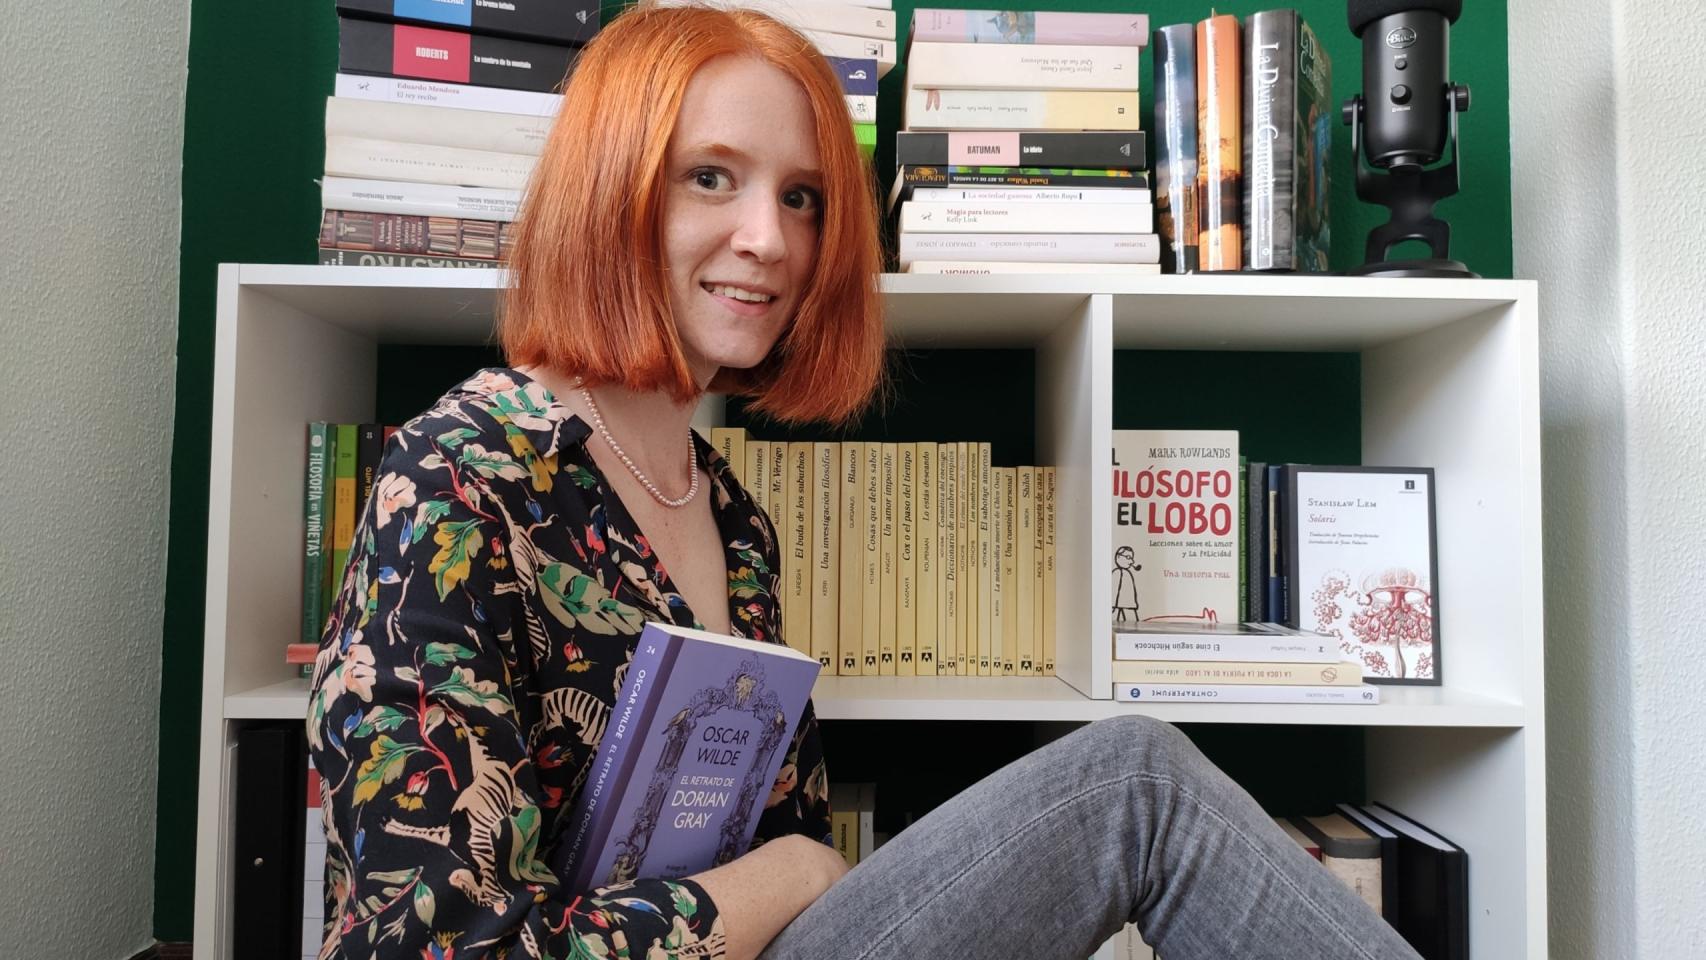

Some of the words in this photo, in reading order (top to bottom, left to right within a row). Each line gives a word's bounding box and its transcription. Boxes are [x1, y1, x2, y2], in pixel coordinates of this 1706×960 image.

[415, 46, 449, 60] ROBERTS
[1259, 42, 1279, 64] La
[397, 82, 428, 91] Eduardo
[428, 84, 460, 94] Mendoza
[1258, 67, 1279, 121] Divina
[967, 145, 1001, 154] BATUMAN
[904, 174, 946, 183] ALFAGUARA
[1006, 176, 1027, 184] Wallace
[1027, 176, 1049, 185] Daniel
[946, 209, 966, 217] Magia
[946, 216, 961, 224] Kelly
[773, 447, 783, 478] Vértigo
[821, 448, 831, 489] filosófica
[847, 449, 857, 484] Blancos
[869, 448, 877, 474] saber
[903, 450, 912, 482] tiempo
[922, 451, 930, 488] deseando
[939, 451, 947, 480] enemigo
[947, 450, 956, 481] propios
[308, 452, 324, 501] FILOSOFÍA
[797, 451, 805, 494] suburbios
[884, 452, 893, 496] imposible
[1113, 464, 1232, 498] ILÓSOFO
[773, 480, 781, 493] Mr.
[868, 481, 877, 503] debes
[902, 484, 911, 499] del
[1005, 475, 1014, 507] personal
[796, 498, 804, 510] los
[922, 489, 930, 510] estás
[946, 483, 955, 519] nombres
[981, 486, 989, 520] sabotaje
[1035, 492, 1042, 502] de
[796, 510, 804, 523] de
[903, 501, 912, 522] paso
[922, 512, 930, 521] Lo
[1046, 503, 1053, 513] de
[821, 491, 831, 549] investigación
[946, 521, 955, 531] de
[980, 521, 988, 531] El
[1005, 510, 1013, 540] cuestión
[1036, 503, 1044, 538] escopeta
[1117, 502, 1142, 526] EL
[1147, 501, 1232, 536] LOBO
[1308, 513, 1336, 523] Solaris
[306, 514, 323, 557] VIÑETAS
[796, 526, 804, 547] buda
[883, 525, 892, 537] Un
[902, 523, 911, 533] el
[867, 524, 877, 552] Cosas
[1035, 539, 1042, 551] La
[1046, 535, 1053, 546] La
[1149, 539, 1183, 547] Lecciones
[1185, 539, 1203, 547] sobre
[1214, 540, 1233, 548] amor
[795, 548, 804, 559] El
[902, 543, 911, 561] Cox
[946, 533, 955, 581] Diccionario
[1005, 543, 1013, 557] Una
[1182, 550, 1187, 558] y
[820, 550, 829, 570] Una
[1163, 569, 1179, 578] Una
[994, 584, 1000, 592] La
[646, 645, 656, 655] 24
[1134, 642, 1170, 651] Hitchcock
[1172, 642, 1195, 651] según
[1213, 644, 1220, 652] El
[628, 669, 646, 705] OSCAR
[615, 706, 633, 740] WILDE
[703, 726, 750, 746] OSCAR
[608, 744, 618, 754] EL
[697, 747, 741, 766] WILDE
[593, 757, 613, 797] RETRATO
[680, 775, 689, 785] EL
[690, 775, 723, 786] RETRATO
[723, 777, 735, 787] DE
[587, 798, 597, 812] DE
[671, 790, 730, 807] DORIAN
[673, 812, 713, 829] GRAY
[573, 812, 591, 851] DORIAN
[563, 851, 577, 876] GRAY
